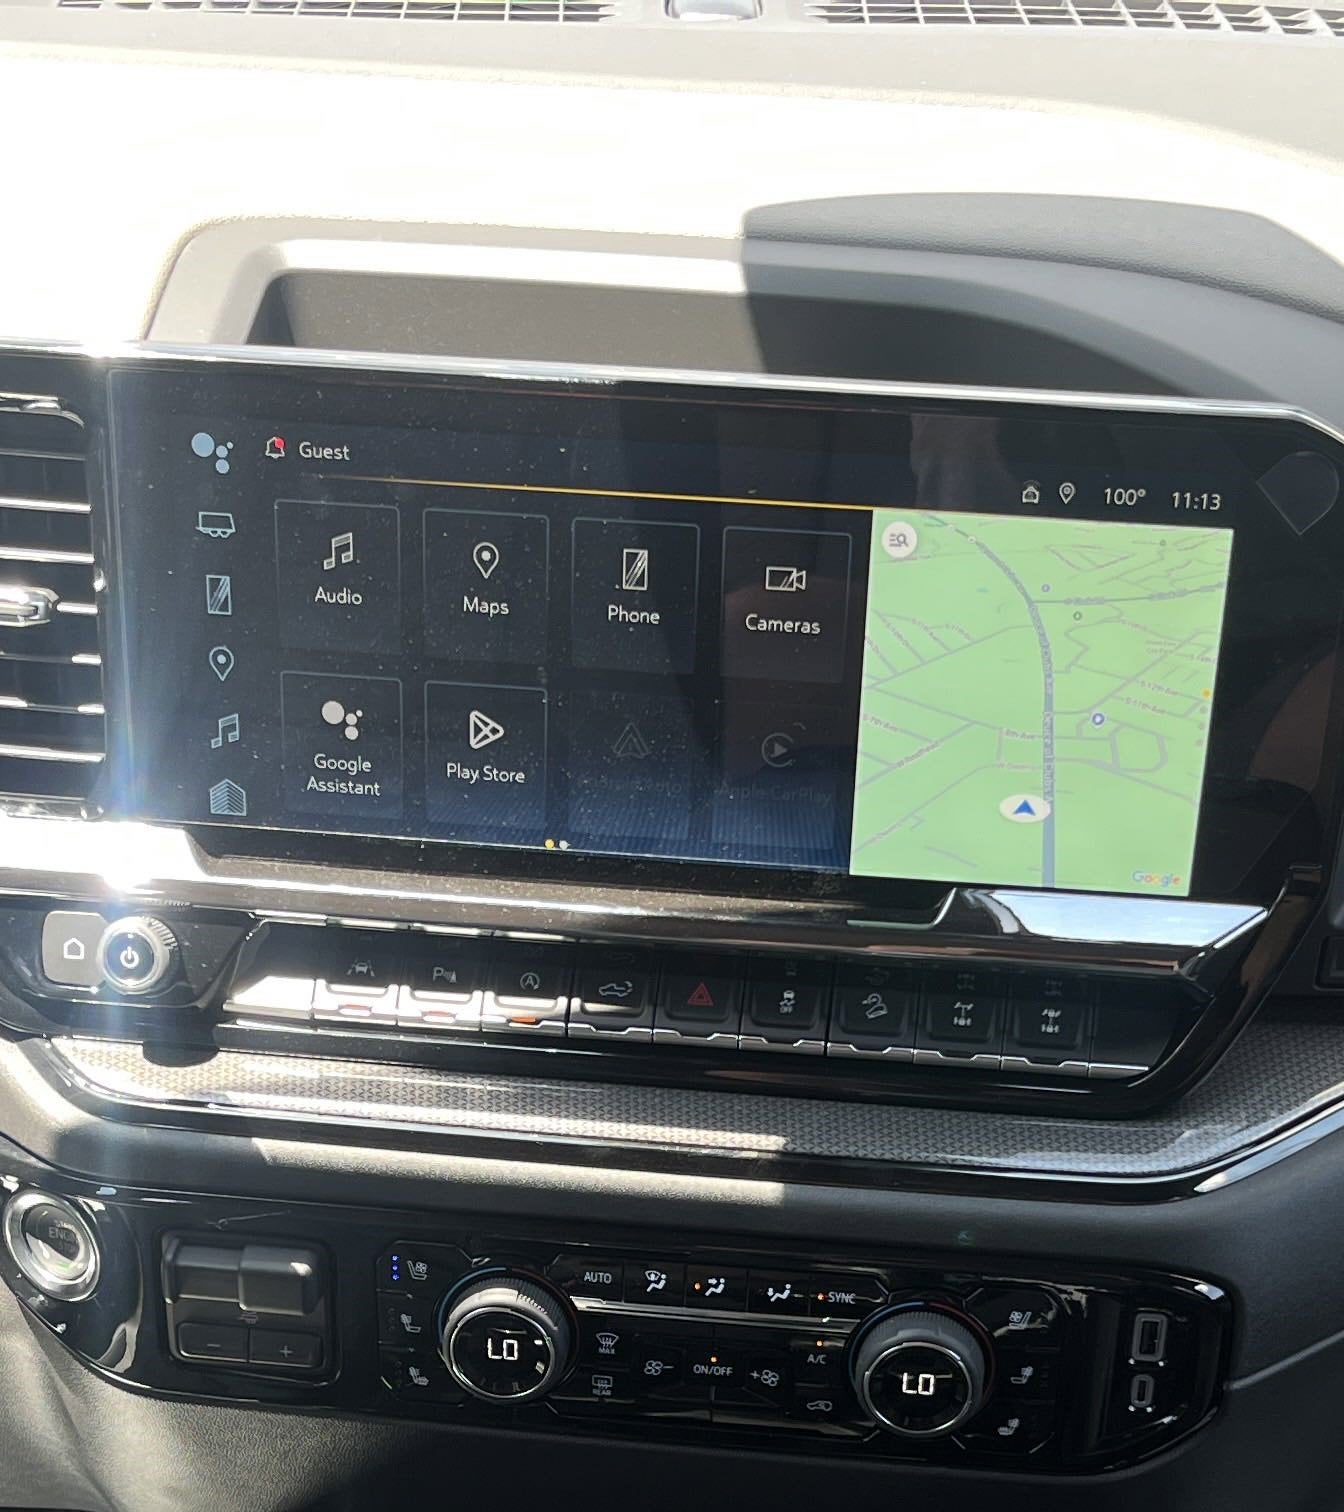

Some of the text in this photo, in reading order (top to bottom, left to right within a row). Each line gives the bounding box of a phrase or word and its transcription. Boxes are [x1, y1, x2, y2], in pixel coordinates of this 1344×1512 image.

[298, 441, 351, 461] Guest
[1172, 491, 1221, 511] 11:13
[314, 586, 363, 606] Audio
[463, 595, 510, 618] Maps
[606, 604, 661, 625] Phone
[744, 612, 821, 635] Cameras
[313, 753, 373, 776] Google
[446, 762, 526, 785] Play Store
[306, 775, 382, 797] Assistant
[1131, 869, 1181, 887] Google
[583, 1271, 613, 1286] AUTO
[826, 1290, 857, 1305] SYNC
[487, 1337, 519, 1361] LO
[806, 1353, 828, 1366] A/C
[692, 1363, 734, 1378] ON/OFF
[902, 1372, 935, 1396] LO
